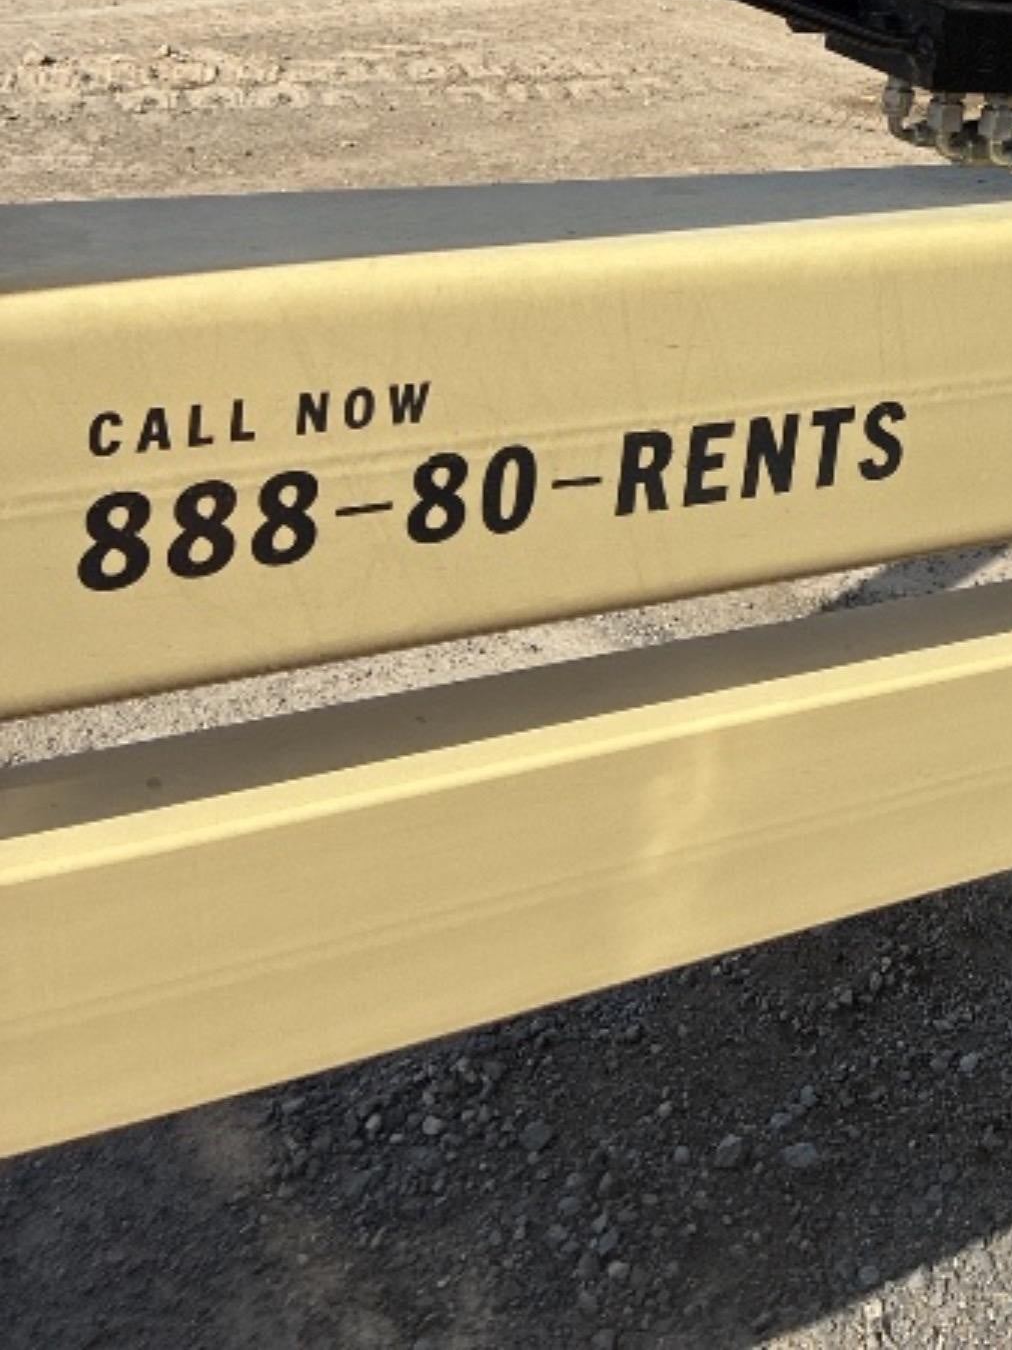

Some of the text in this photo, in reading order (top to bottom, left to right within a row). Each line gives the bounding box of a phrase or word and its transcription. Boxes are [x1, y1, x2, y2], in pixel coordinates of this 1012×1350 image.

[88, 382, 431, 457] CALL NOW
[78, 401, 907, 592] 888-80-RENTS
